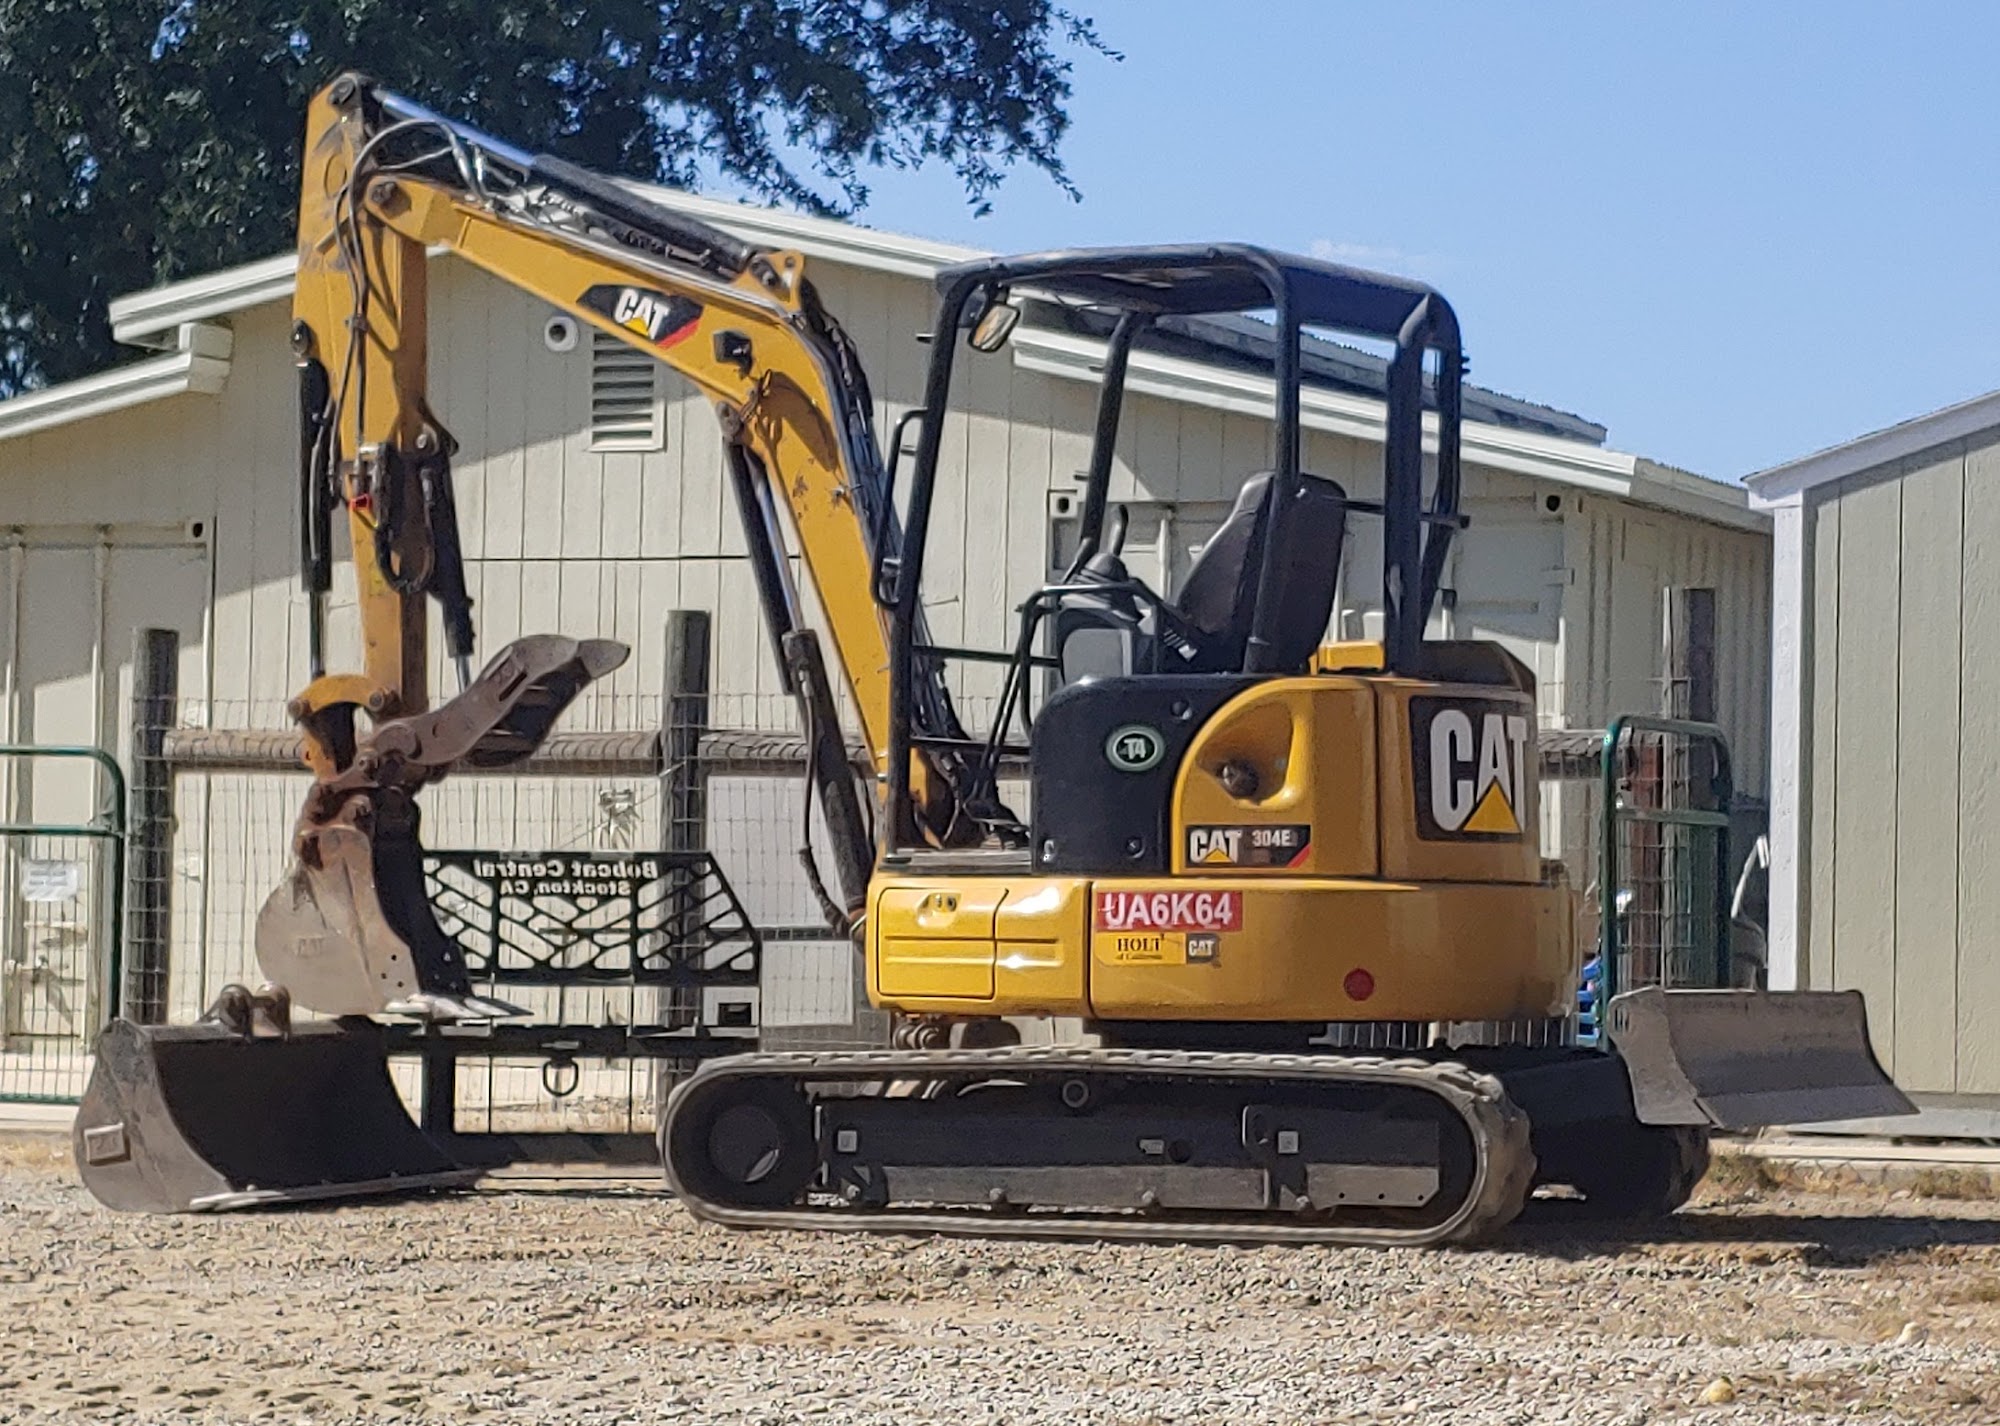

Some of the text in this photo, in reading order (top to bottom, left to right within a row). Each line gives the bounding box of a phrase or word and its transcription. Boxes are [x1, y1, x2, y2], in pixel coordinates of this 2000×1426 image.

[614, 288, 671, 340] CAT
[1430, 709, 1527, 833] CAT
[1190, 829, 1291, 864] CAT 304E
[1104, 892, 1233, 927] UA6K64
[1117, 937, 1215, 956] HOLT CAT
